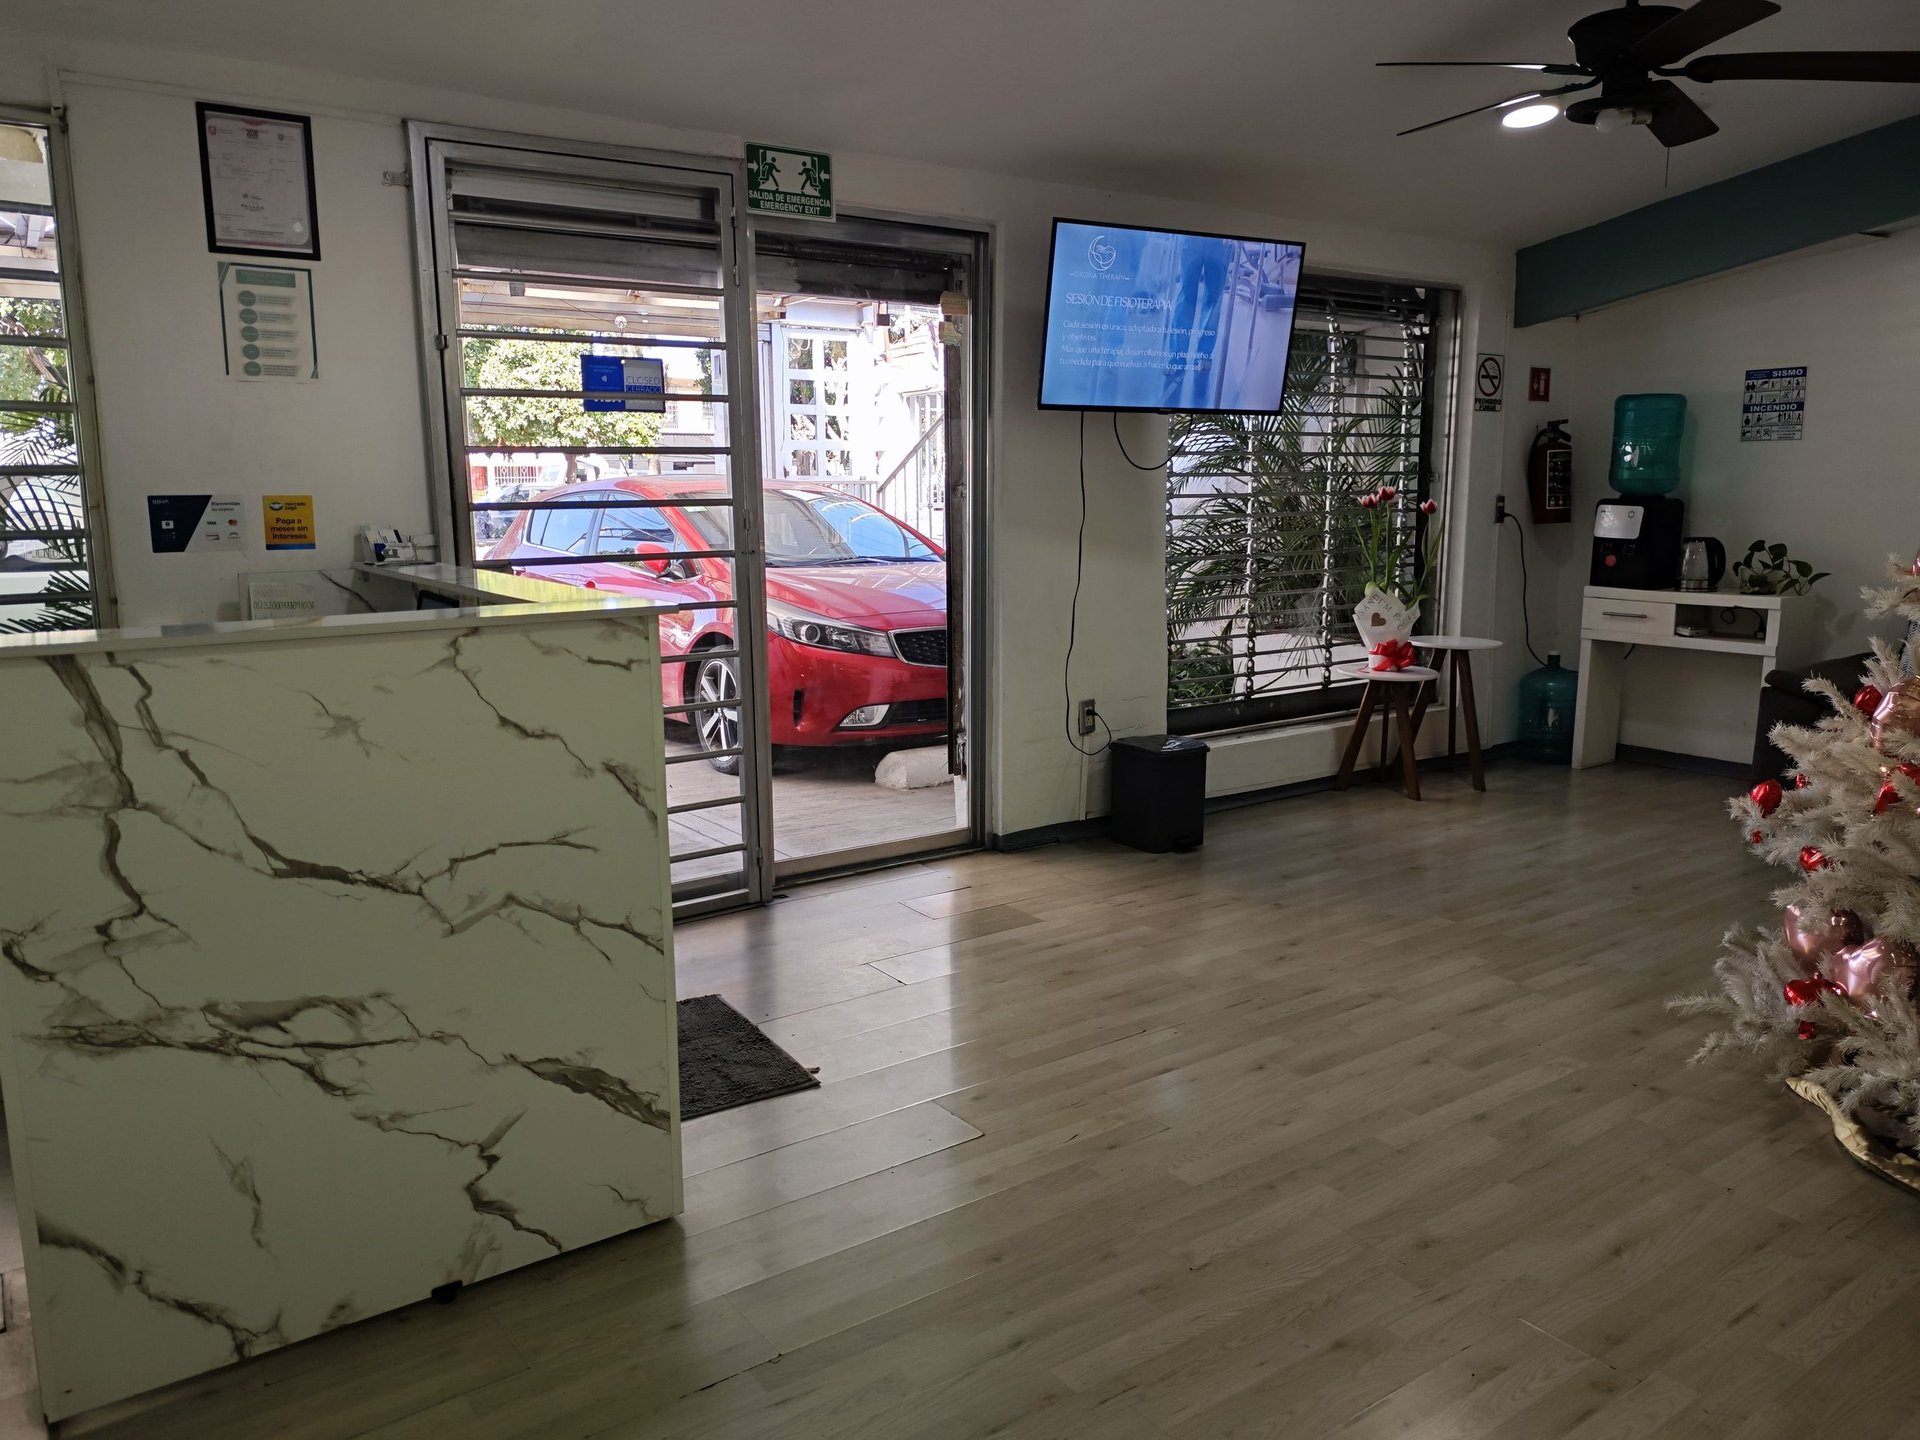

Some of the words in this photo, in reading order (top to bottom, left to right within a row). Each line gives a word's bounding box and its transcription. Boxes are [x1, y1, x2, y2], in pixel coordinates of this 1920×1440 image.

[748, 190, 774, 201] SALIDA
[775, 194, 785, 202] DE
[786, 195, 831, 207] EMERGENCIA
[760, 200, 804, 213] EMERGENCY
[805, 206, 821, 215] EXIT
[1065, 291, 1100, 306] SESIÓN
[1100, 294, 1114, 306] DE
[1114, 296, 1172, 311] FISIOTERAPIA
[1063, 320, 1080, 329] Cada
[1772, 369, 1803, 377] SISMO
[625, 375, 660, 385] CLOSED
[626, 385, 661, 393] CERRADO
[1750, 403, 1798, 412] INCENDIO
[275, 518, 296, 526] Paga
